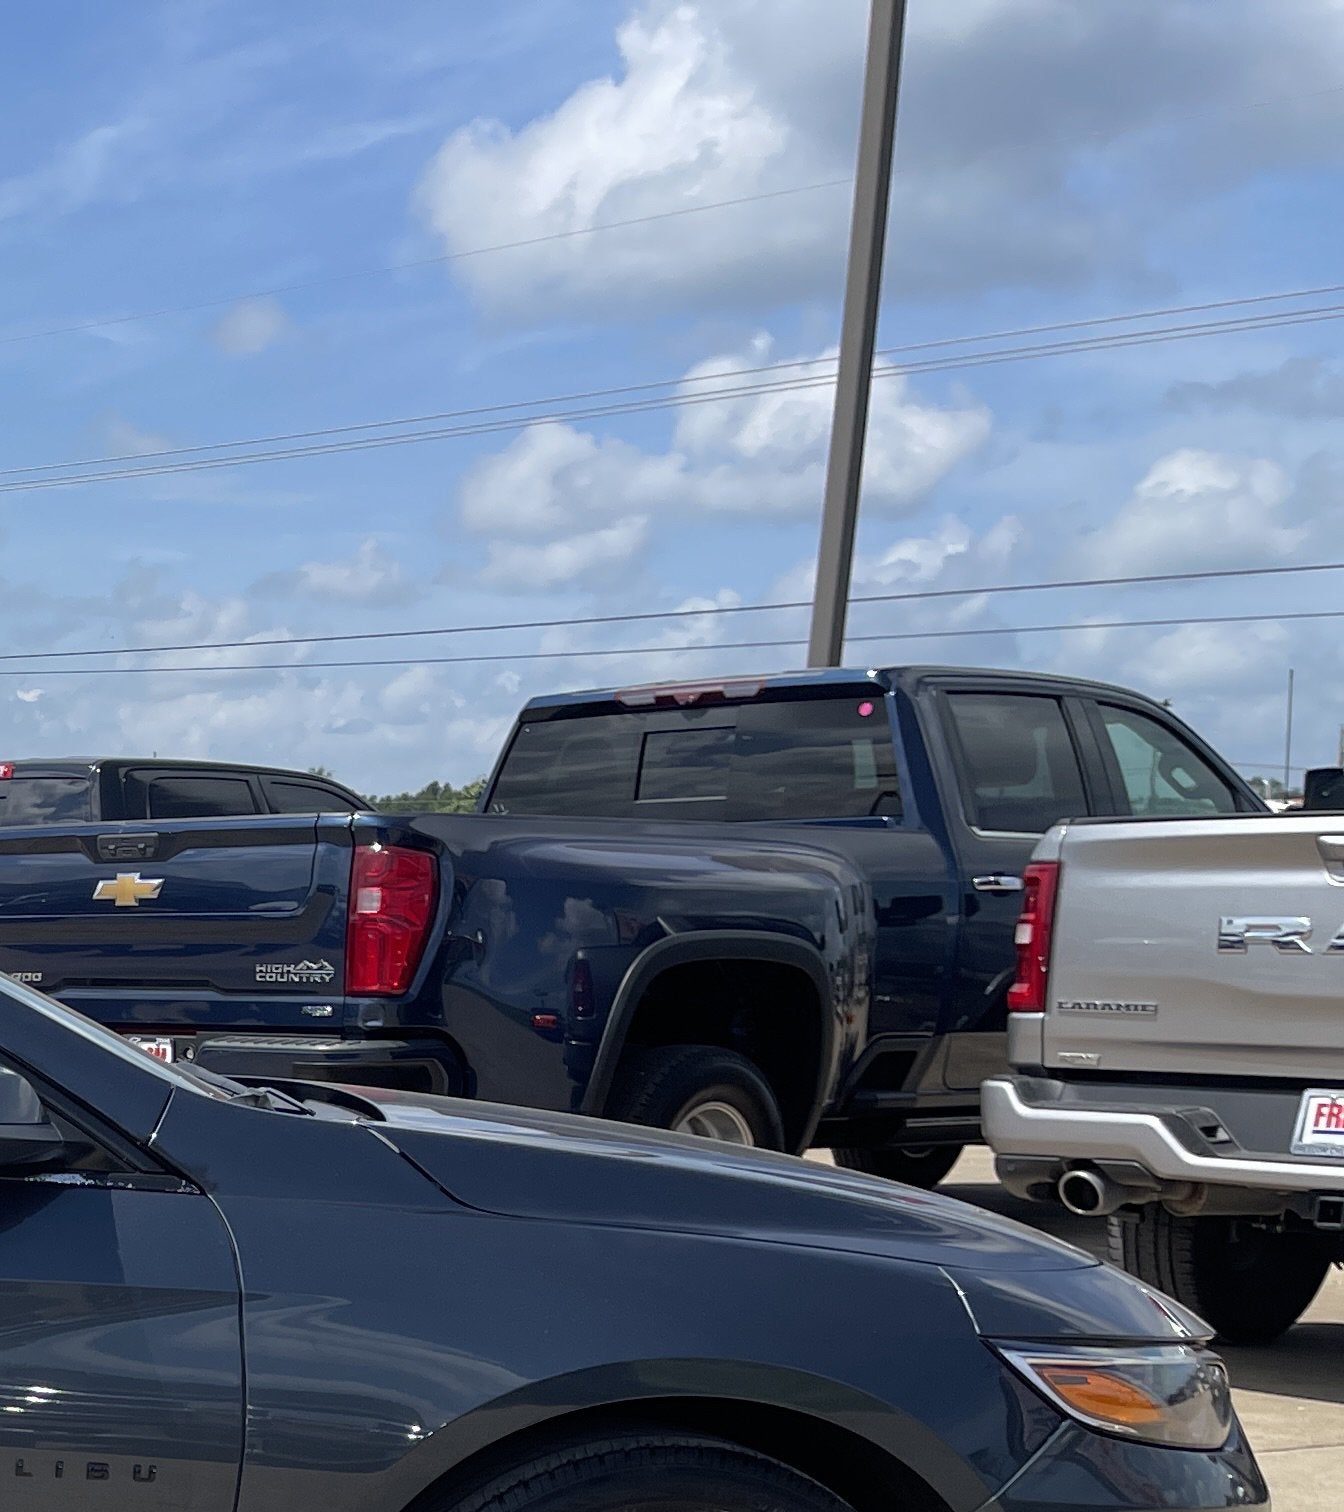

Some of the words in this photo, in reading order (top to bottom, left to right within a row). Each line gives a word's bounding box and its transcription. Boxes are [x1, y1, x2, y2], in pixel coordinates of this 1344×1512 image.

[255, 963, 295, 973] HIGH
[255, 972, 335, 983] COUNTRY
[1313, 1103, 1344, 1128] FR
